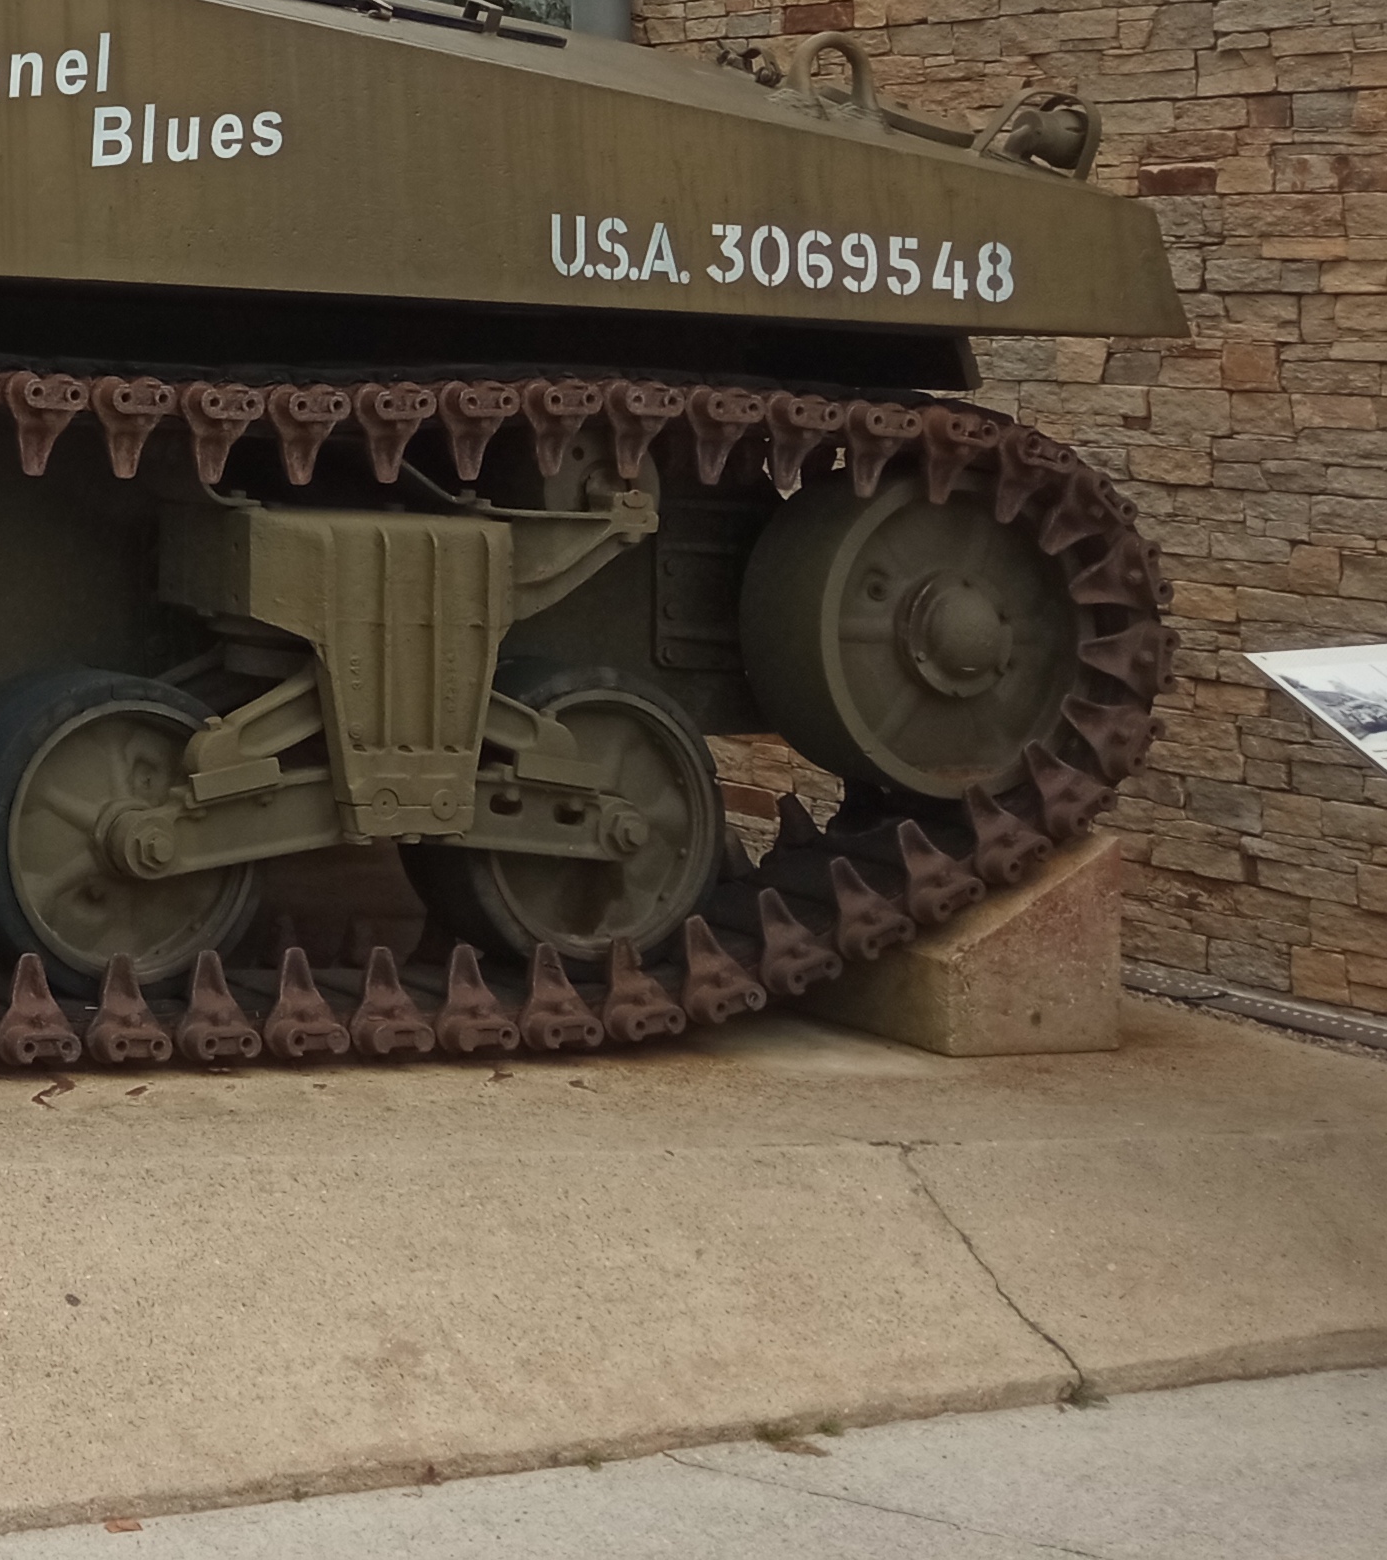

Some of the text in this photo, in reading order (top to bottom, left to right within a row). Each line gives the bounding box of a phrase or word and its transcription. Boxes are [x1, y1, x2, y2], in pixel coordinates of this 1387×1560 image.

[91, 103, 284, 168] Blues
[550, 213, 1015, 303] U.S.A. 3069548
